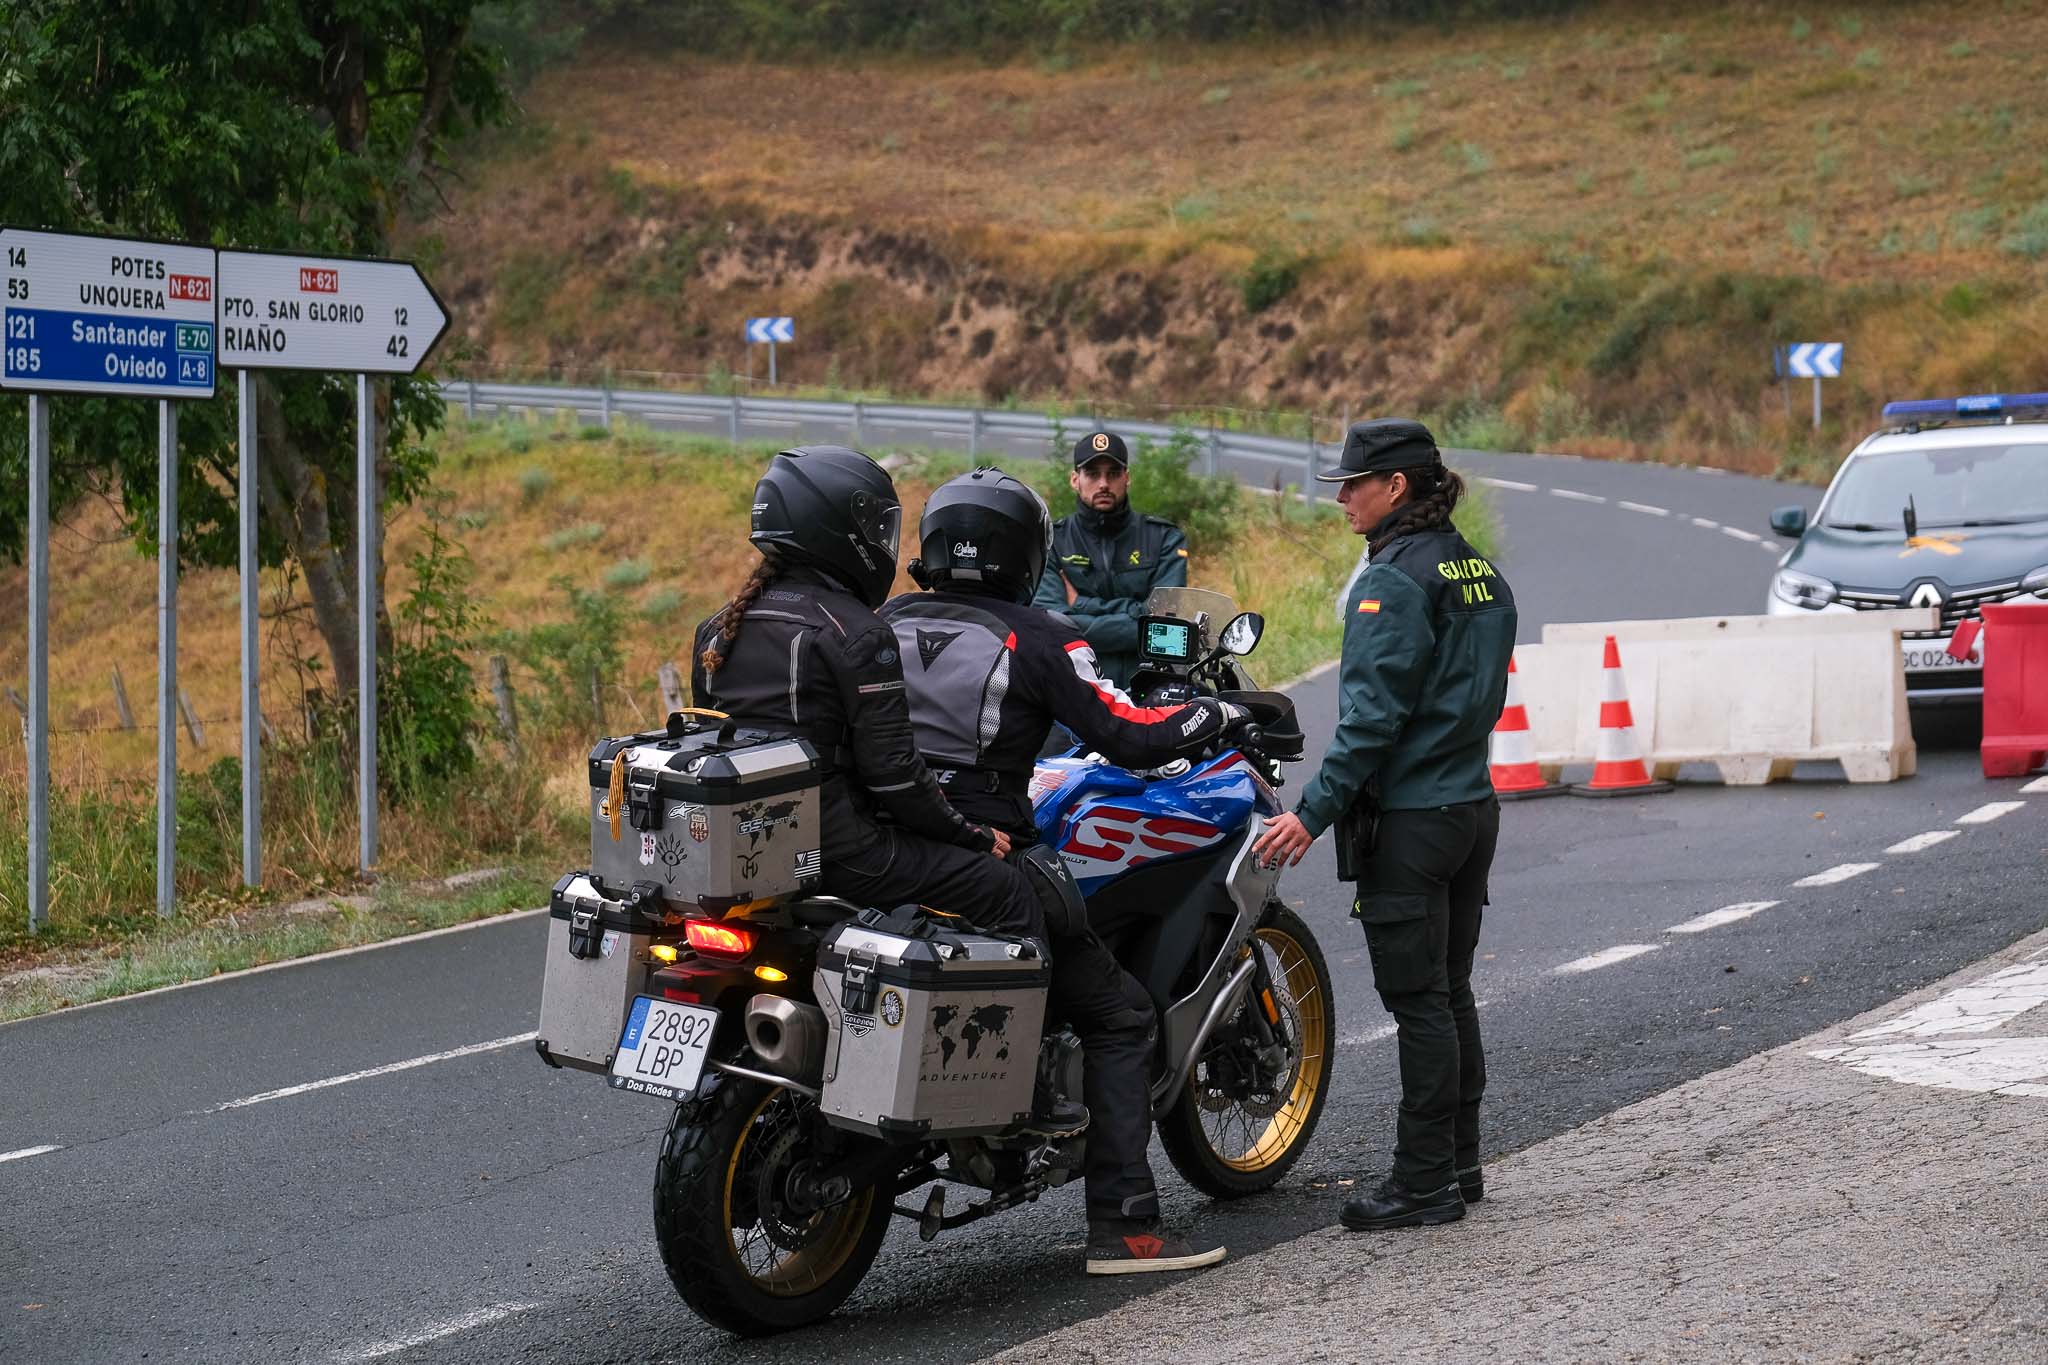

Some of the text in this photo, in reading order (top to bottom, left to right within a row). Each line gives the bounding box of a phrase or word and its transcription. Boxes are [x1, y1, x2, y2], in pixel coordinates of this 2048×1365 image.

[8, 247, 166, 280] 14 POTES
[8, 278, 166, 310] 53 UNQUERA
[171, 278, 210, 298] N-621
[301, 271, 337, 291] N-621
[224, 298, 408, 326] PTO. SAN GLORIO 12
[7, 315, 209, 348] 121 Santander E-70
[224, 323, 408, 357] RIAÑO 42
[7, 347, 206, 379] 185 Oviedo A-8
[1180, 706, 1210, 737] DAINESE
[738, 818, 763, 834] GS
[628, 1028, 638, 1040] E
[647, 1009, 710, 1049] 2892
[636, 1042, 684, 1078] LBP
[626, 1079, 673, 1098] Dos Rodes
[920, 1071, 1008, 1082] ADVENTURE
